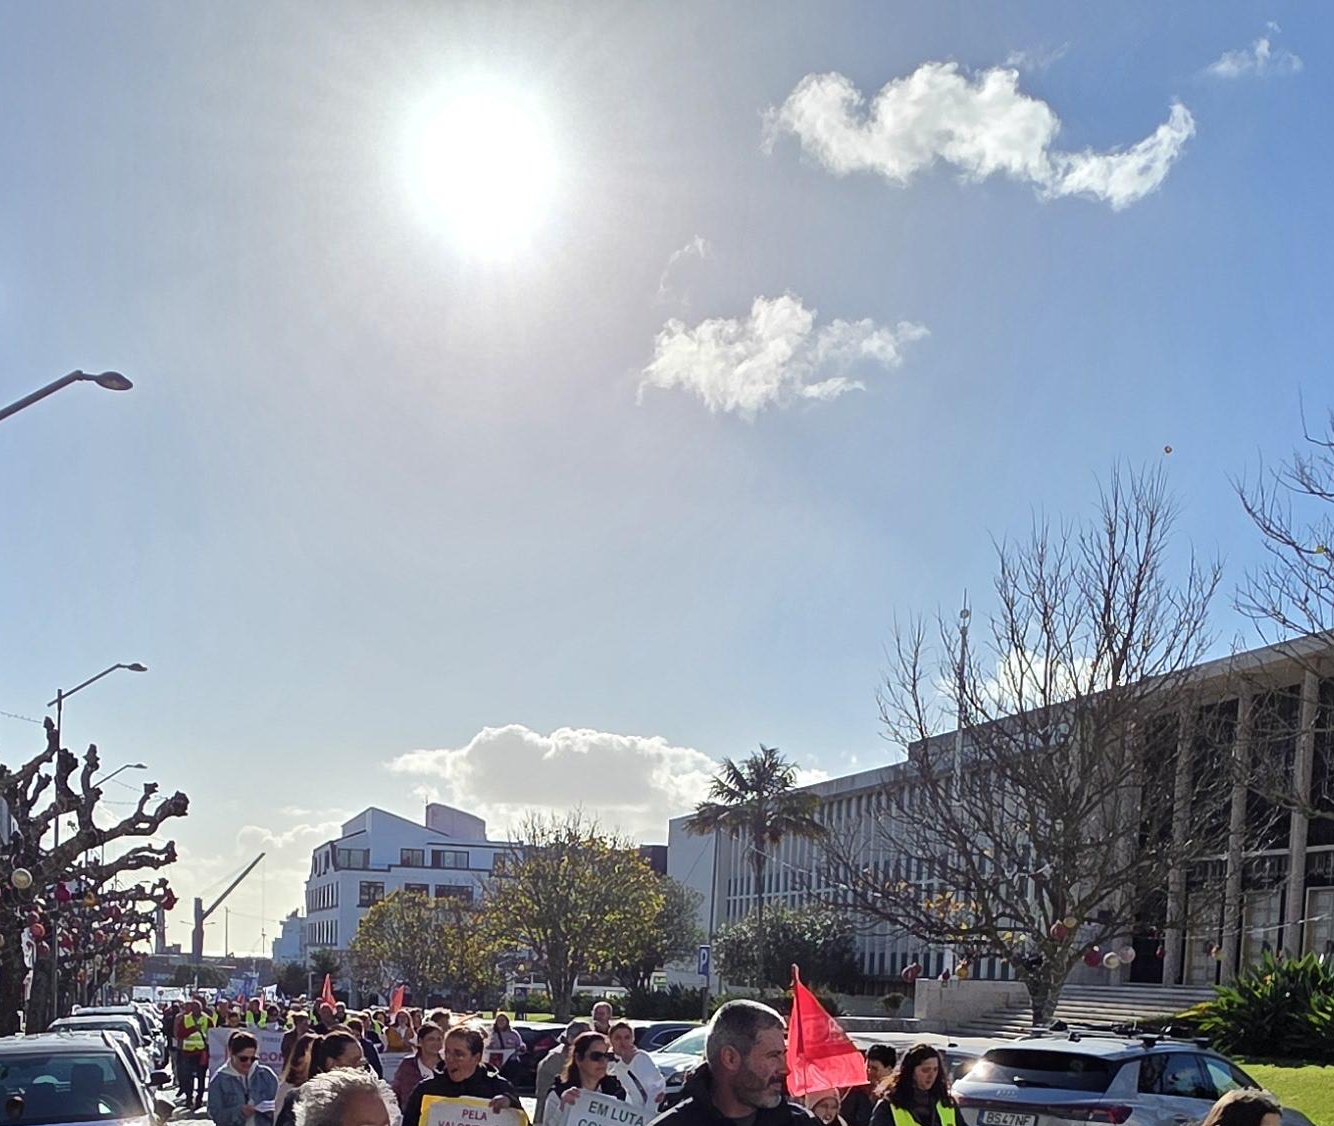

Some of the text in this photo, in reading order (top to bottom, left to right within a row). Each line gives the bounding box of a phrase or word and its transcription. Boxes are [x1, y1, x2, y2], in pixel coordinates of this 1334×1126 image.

[699, 948, 708, 975] P
[461, 1108, 487, 1121] PELA
[588, 1101, 644, 1126] EM LUTA
[986, 1112, 1031, 1126] BS47NF
